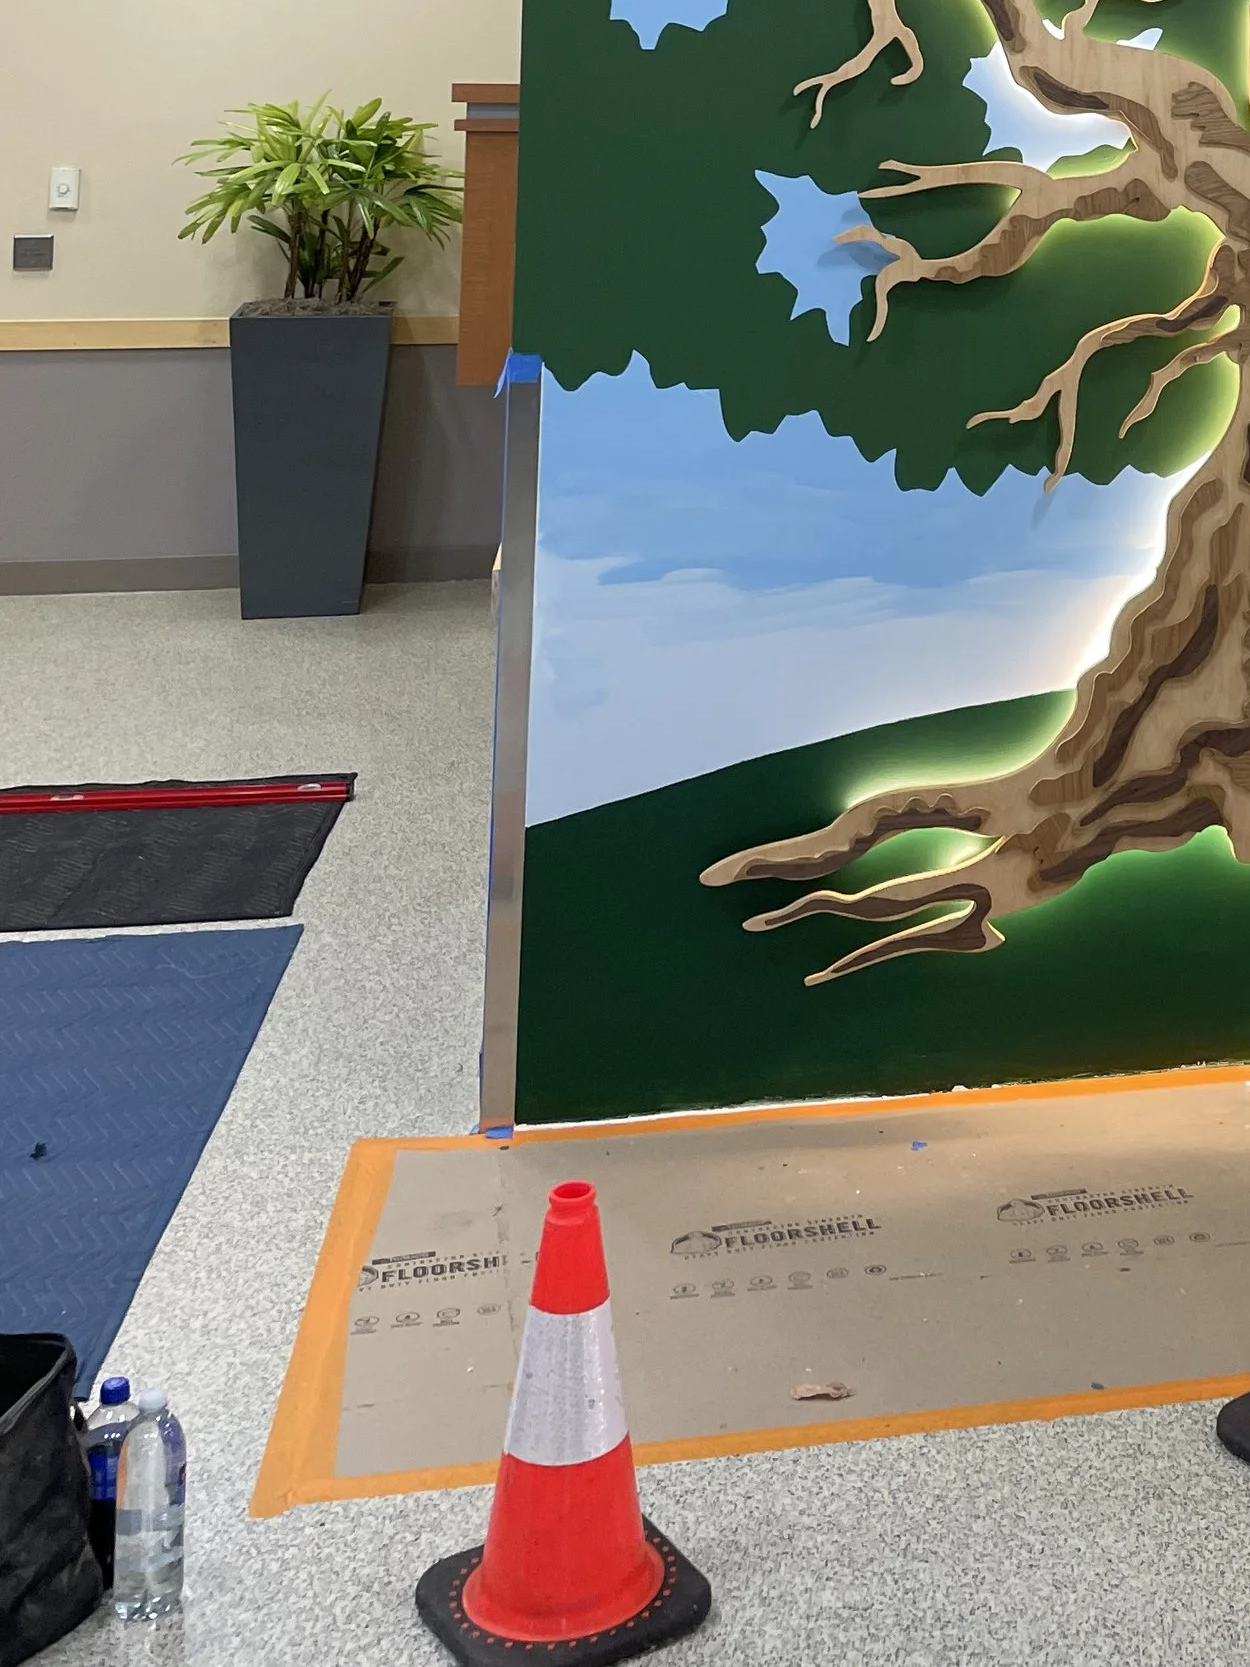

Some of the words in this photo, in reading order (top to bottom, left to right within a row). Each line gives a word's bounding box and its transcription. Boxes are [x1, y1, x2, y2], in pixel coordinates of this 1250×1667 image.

[1046, 1188, 1194, 1216] FLOORSHELL
[725, 1218, 881, 1248] FLOORSHELL
[381, 1256, 503, 1283] FLOORSH
